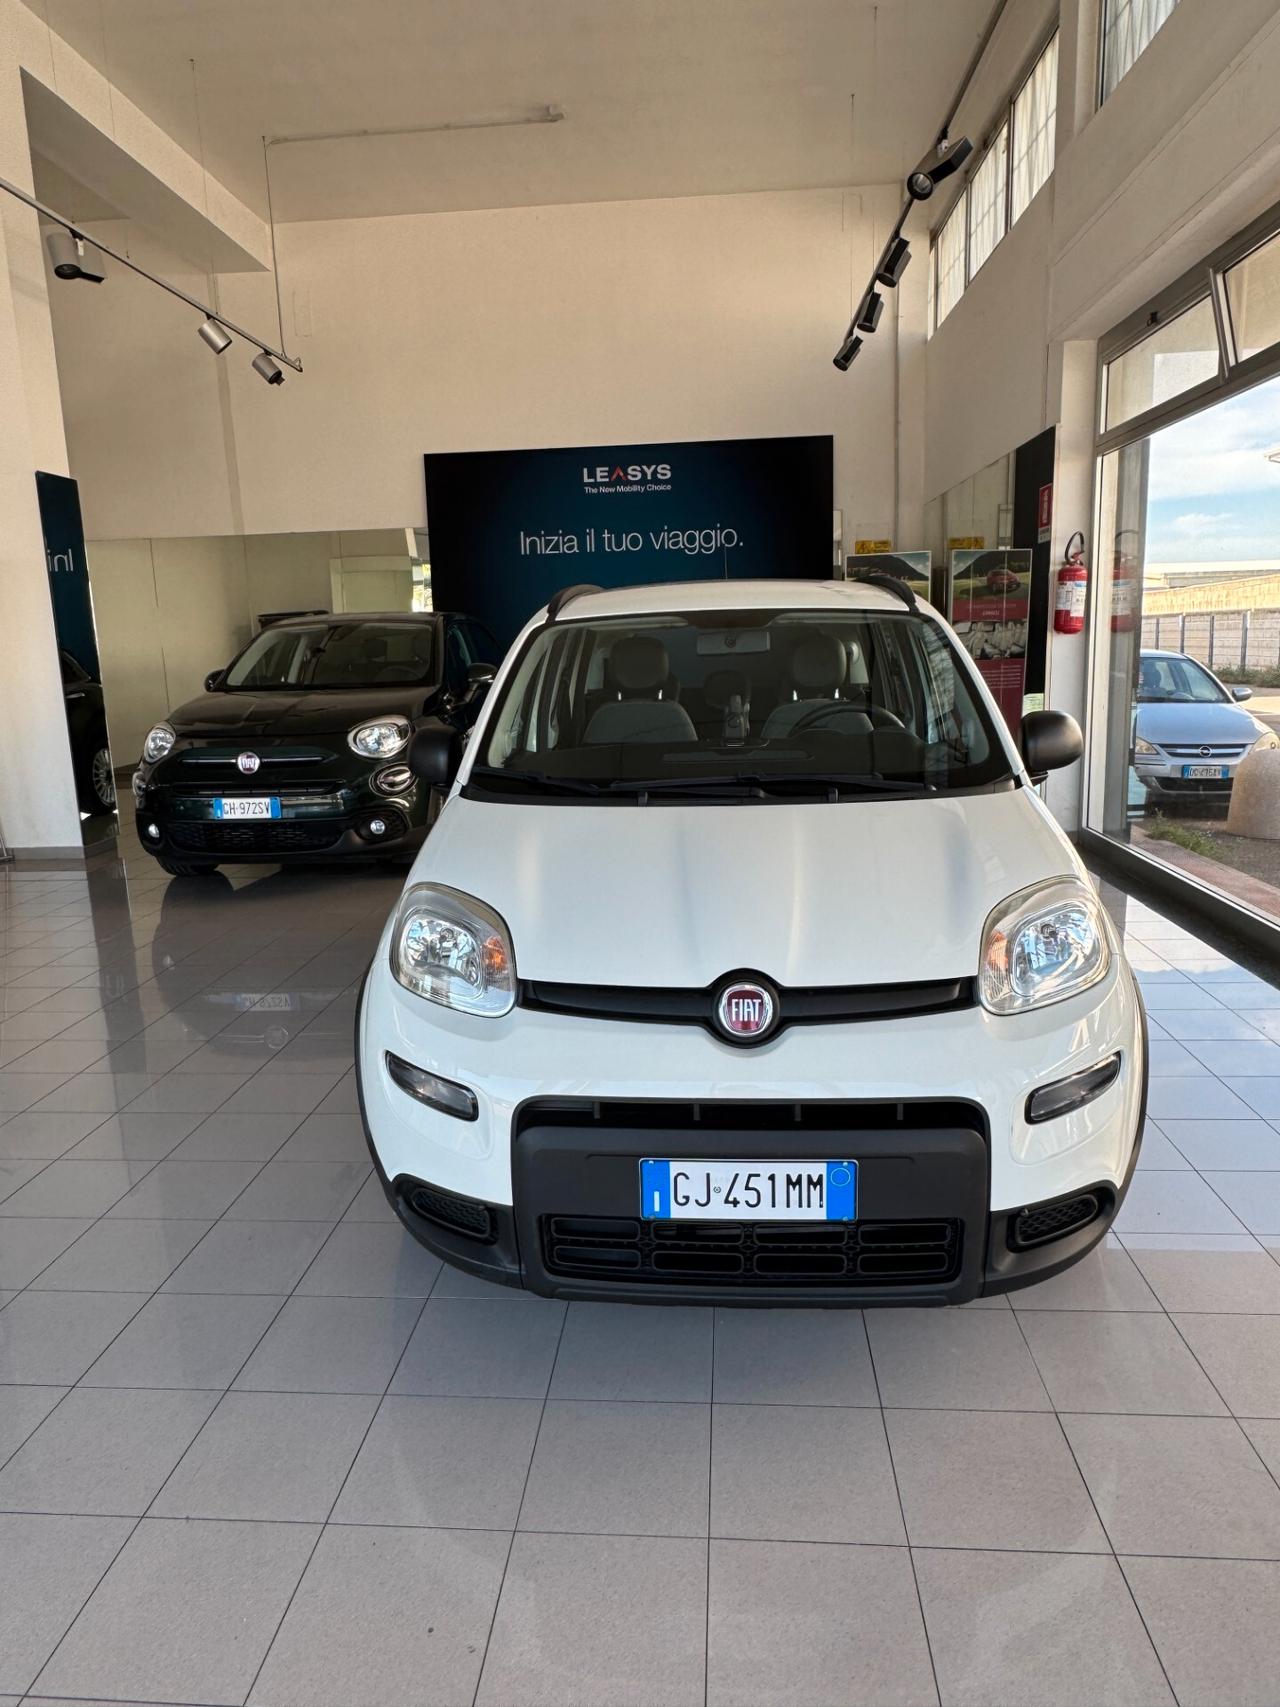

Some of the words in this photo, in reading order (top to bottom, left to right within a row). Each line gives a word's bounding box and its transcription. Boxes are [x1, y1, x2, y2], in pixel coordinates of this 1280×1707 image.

[583, 464, 672, 483] LEASYS
[600, 485, 616, 493] New
[617, 484, 646, 493] Mobility
[647, 483, 672, 491] Choice
[520, 530, 579, 555] Inizia
[586, 528, 595, 552] il
[602, 529, 643, 551] tuo
[649, 523, 744, 555] viaggio.
[731, 999, 762, 1021] FIAT
